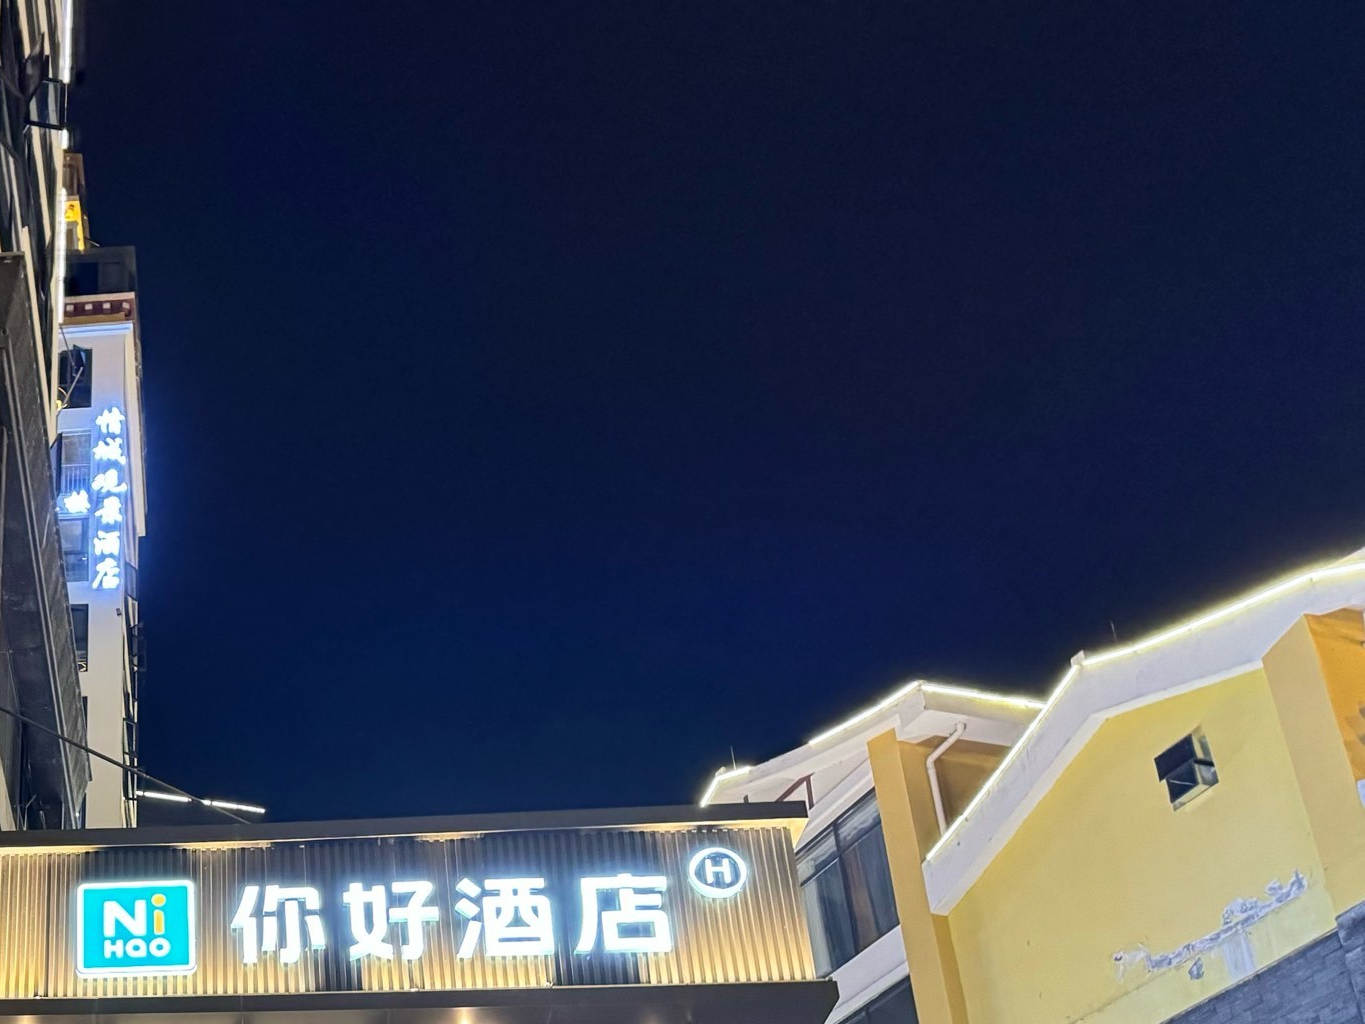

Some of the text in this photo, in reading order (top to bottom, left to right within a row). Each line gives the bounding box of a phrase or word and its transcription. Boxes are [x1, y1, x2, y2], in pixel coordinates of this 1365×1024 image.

[704, 857, 733, 885] H
[102, 893, 167, 938] Ni
[231, 873, 673, 965] 你好酒店
